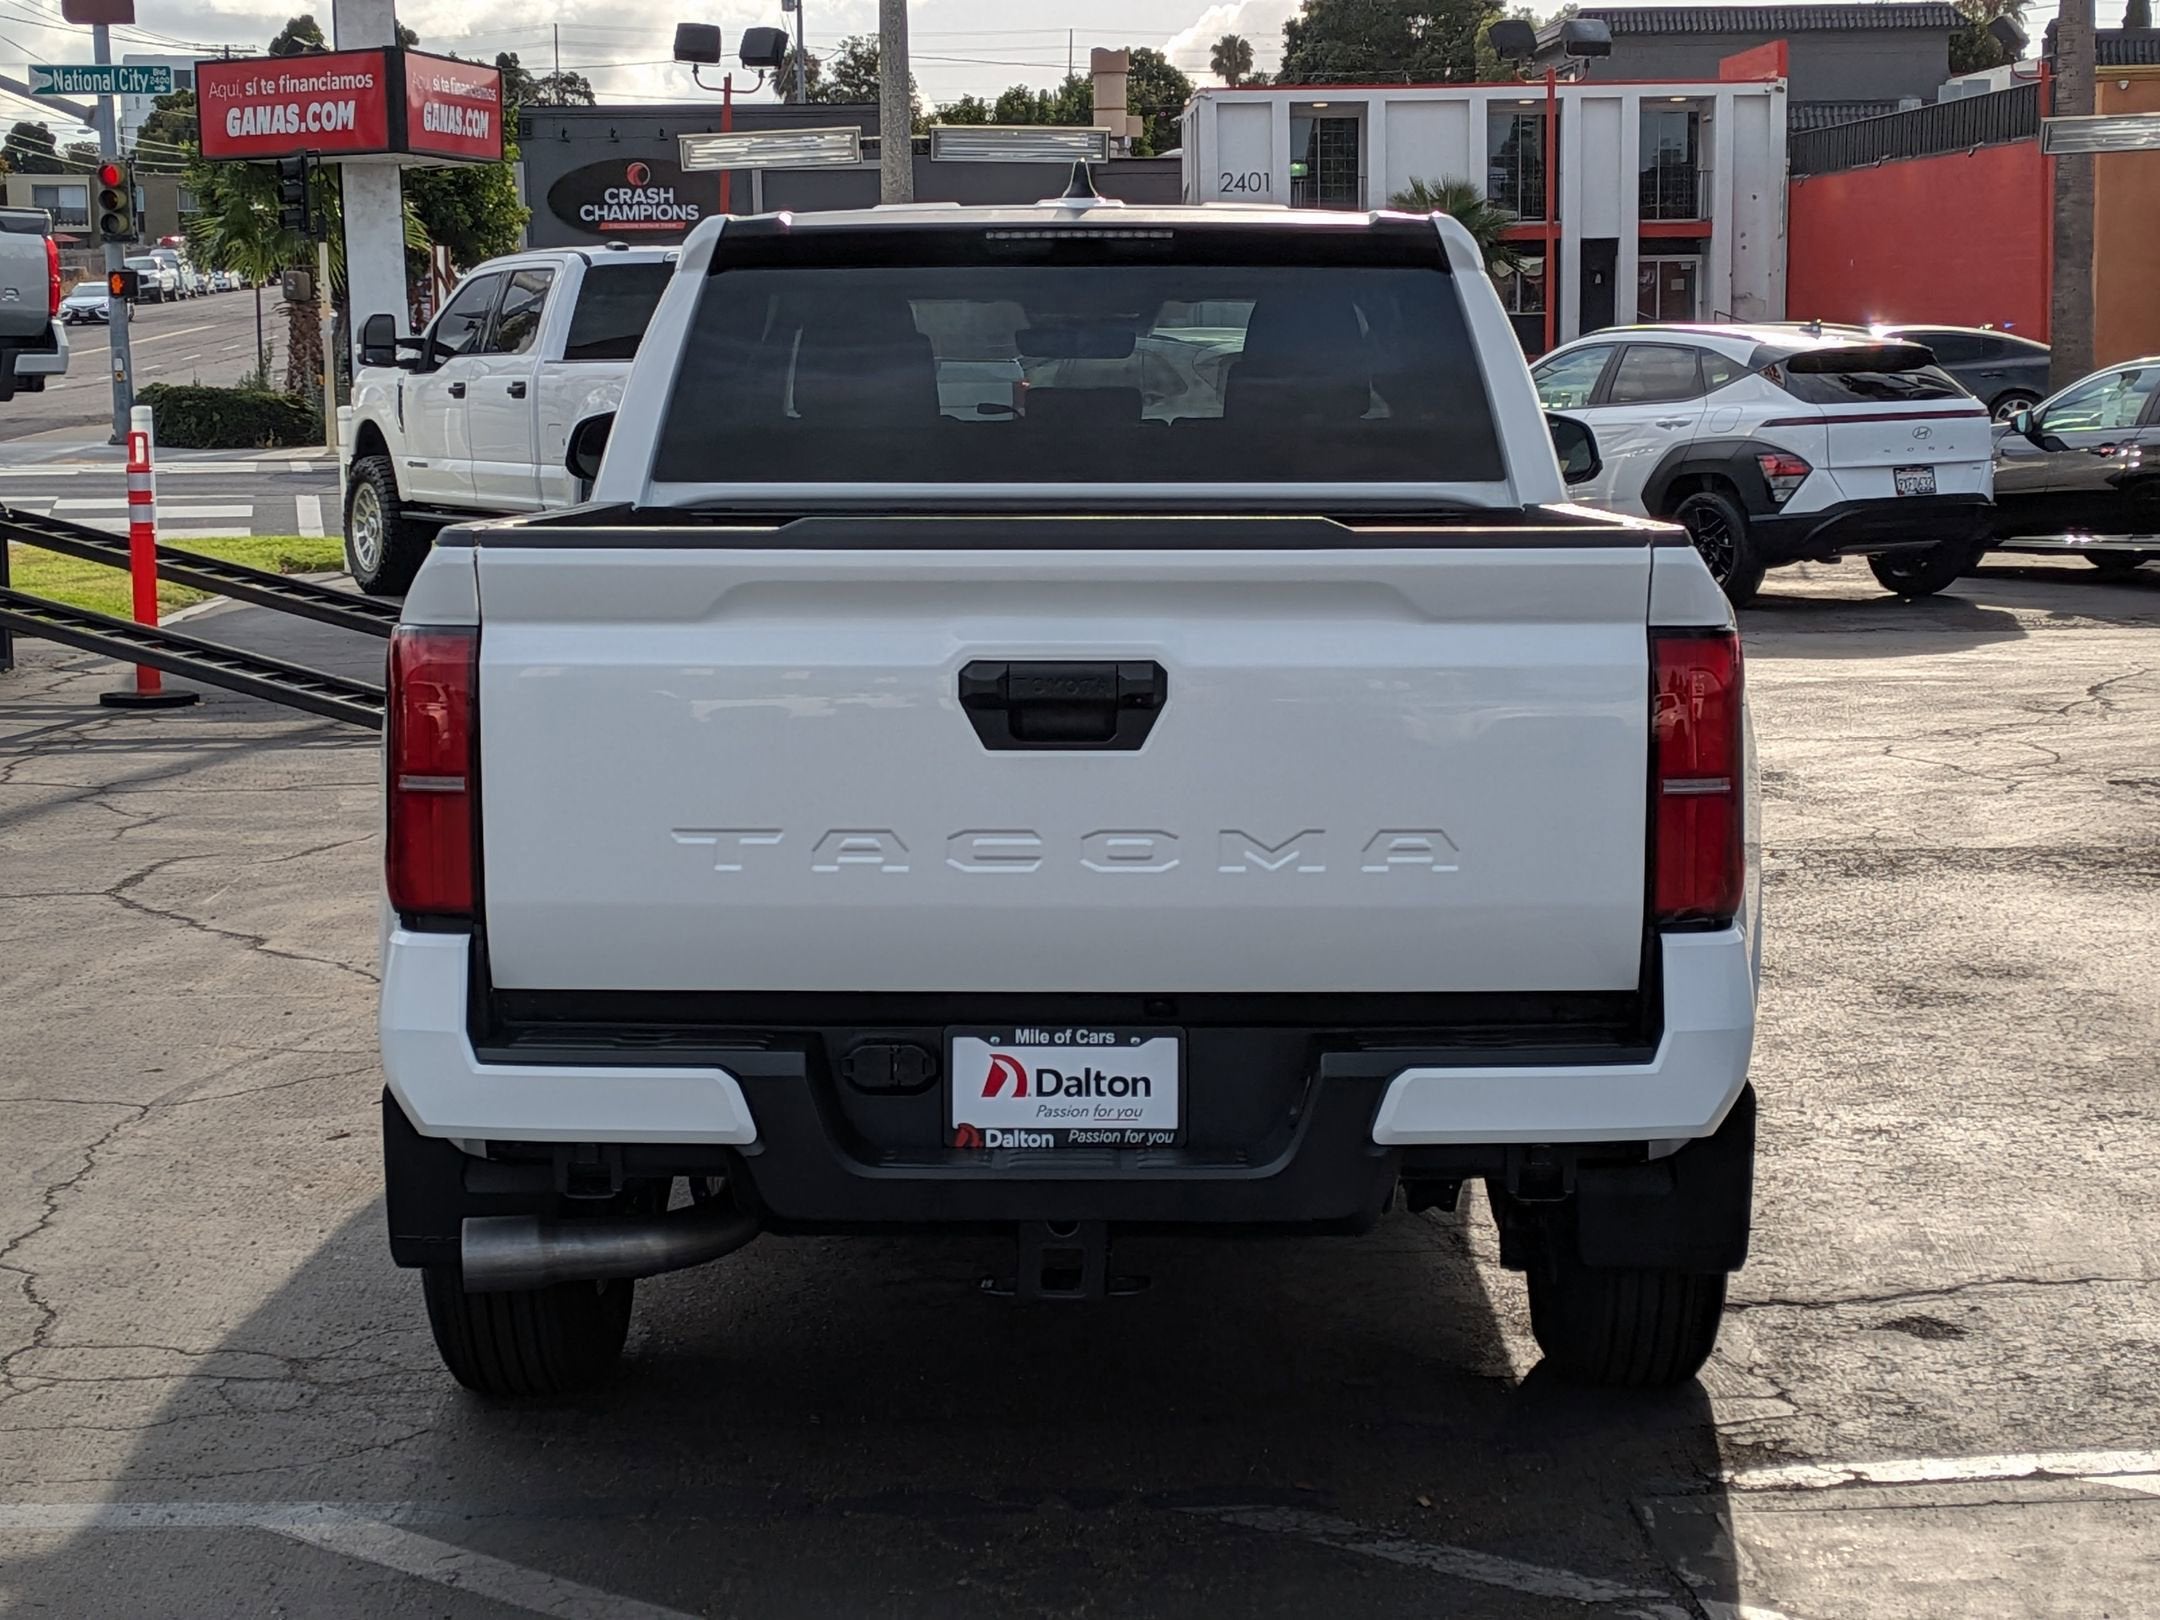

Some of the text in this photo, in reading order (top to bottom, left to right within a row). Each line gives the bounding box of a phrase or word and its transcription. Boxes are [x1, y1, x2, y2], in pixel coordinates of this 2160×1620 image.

[52, 68, 167, 93] National City Blvd
[149, 76, 170, 84] 2400
[260, 78, 276, 95] te
[279, 71, 374, 94] financiamos
[226, 100, 356, 138] GANAS.COM
[423, 101, 490, 140] GANAS.COM
[1220, 171, 1271, 193] 2401
[604, 187, 675, 205] CRASH
[579, 204, 700, 222] CHAMPIONS
[671, 828, 1460, 873] TACOMA
[1015, 1028, 1116, 1044] Mile of Cars
[1035, 1067, 1152, 1098] Dalton
[1035, 1104, 1143, 1119] Passion for you
[985, 1129, 1174, 1148] Dalton Passion for you
